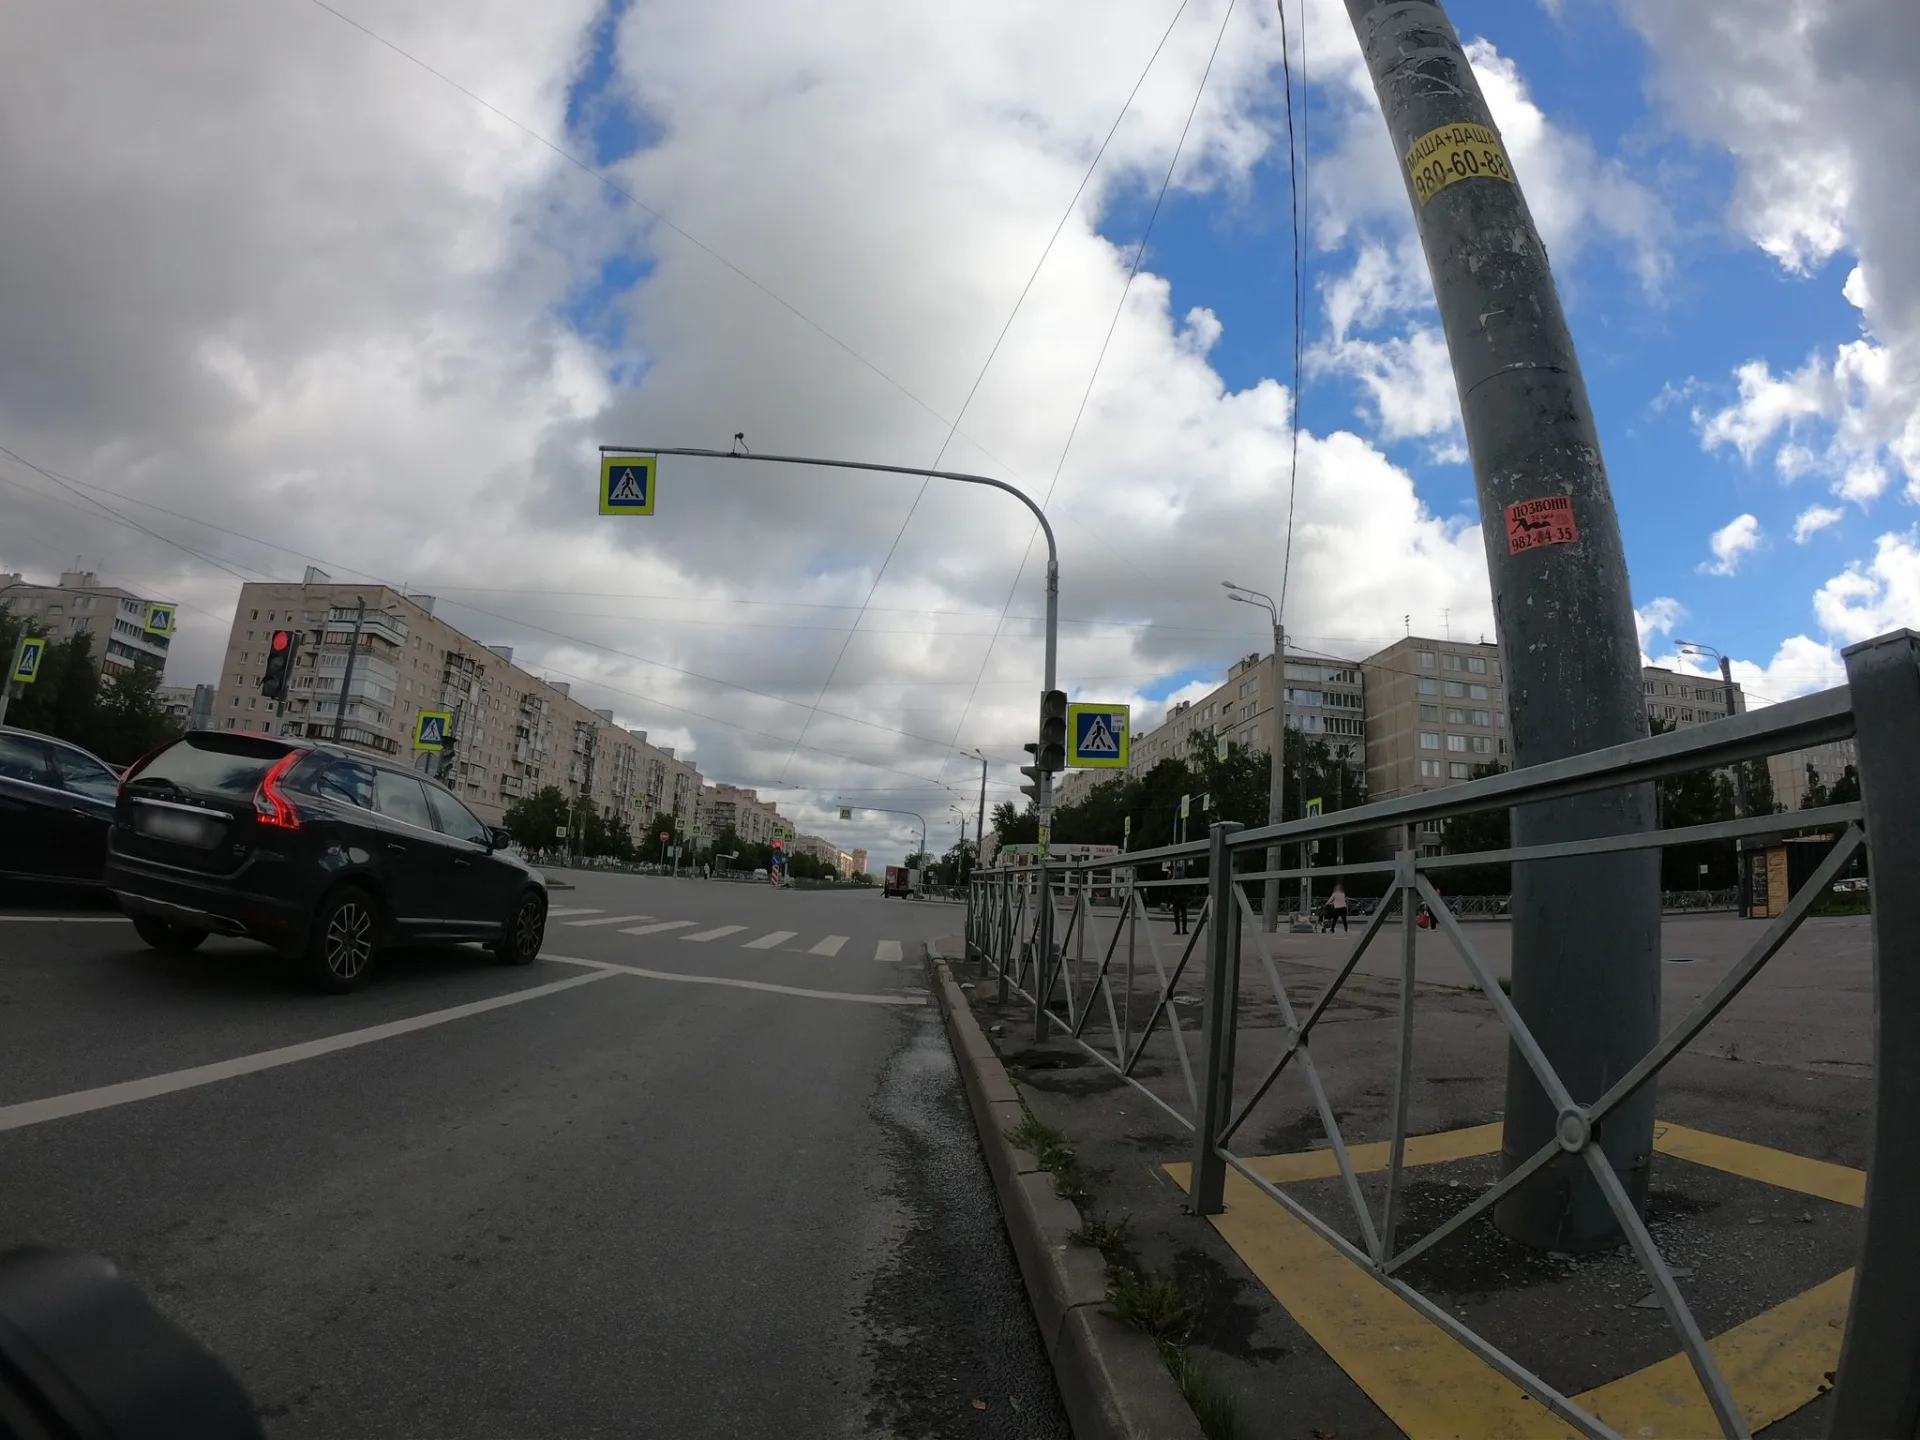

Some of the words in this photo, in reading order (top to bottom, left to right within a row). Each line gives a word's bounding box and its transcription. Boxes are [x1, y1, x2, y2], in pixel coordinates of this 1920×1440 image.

[1407, 127, 1494, 172] МАША+ДАША
[1415, 149, 1510, 195] 980-60-88
[1512, 497, 1568, 519] ПОЗВОНИ
